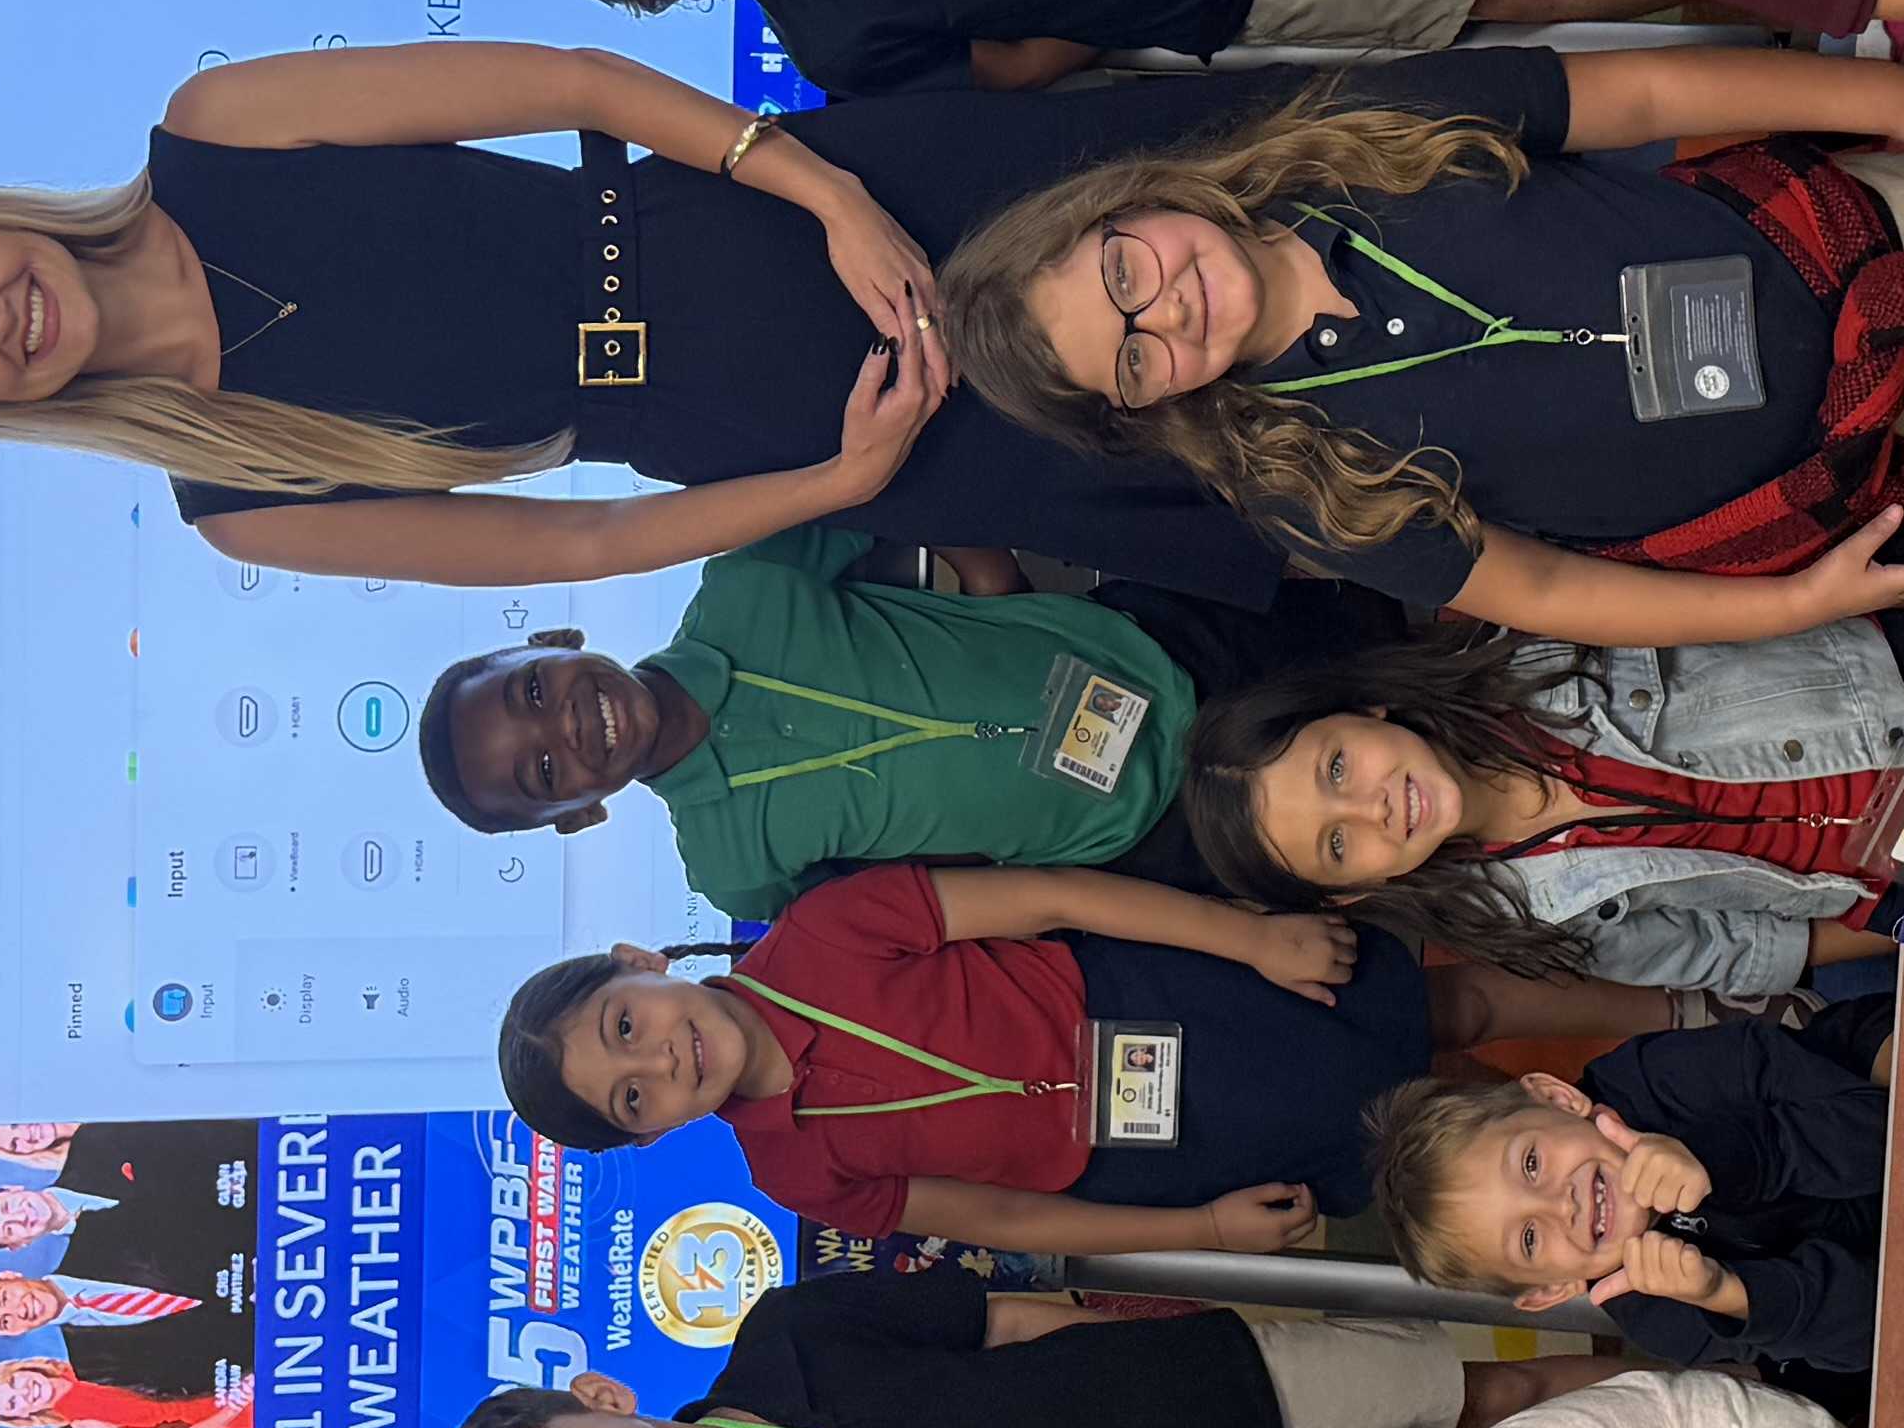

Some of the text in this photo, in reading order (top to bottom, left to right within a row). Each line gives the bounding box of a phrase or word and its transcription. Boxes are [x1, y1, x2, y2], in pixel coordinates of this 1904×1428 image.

[167, 850, 188, 898] Input
[67, 981, 84, 1039] Pinned
[200, 984, 216, 1019] Input
[299, 973, 317, 1024] Display
[396, 977, 411, 1017] Audio
[489, 1138, 531, 1310] WPBF
[561, 1161, 584, 1309] WEATHER
[533, 1220, 555, 1308] FIRST
[606, 1208, 634, 1351] WeatheRate
[642, 1230, 671, 1322] CERTIFIED
[676, 1229, 746, 1322] 13
[745, 1246, 758, 1299] YEARS
[274, 1335, 324, 1395] IN
